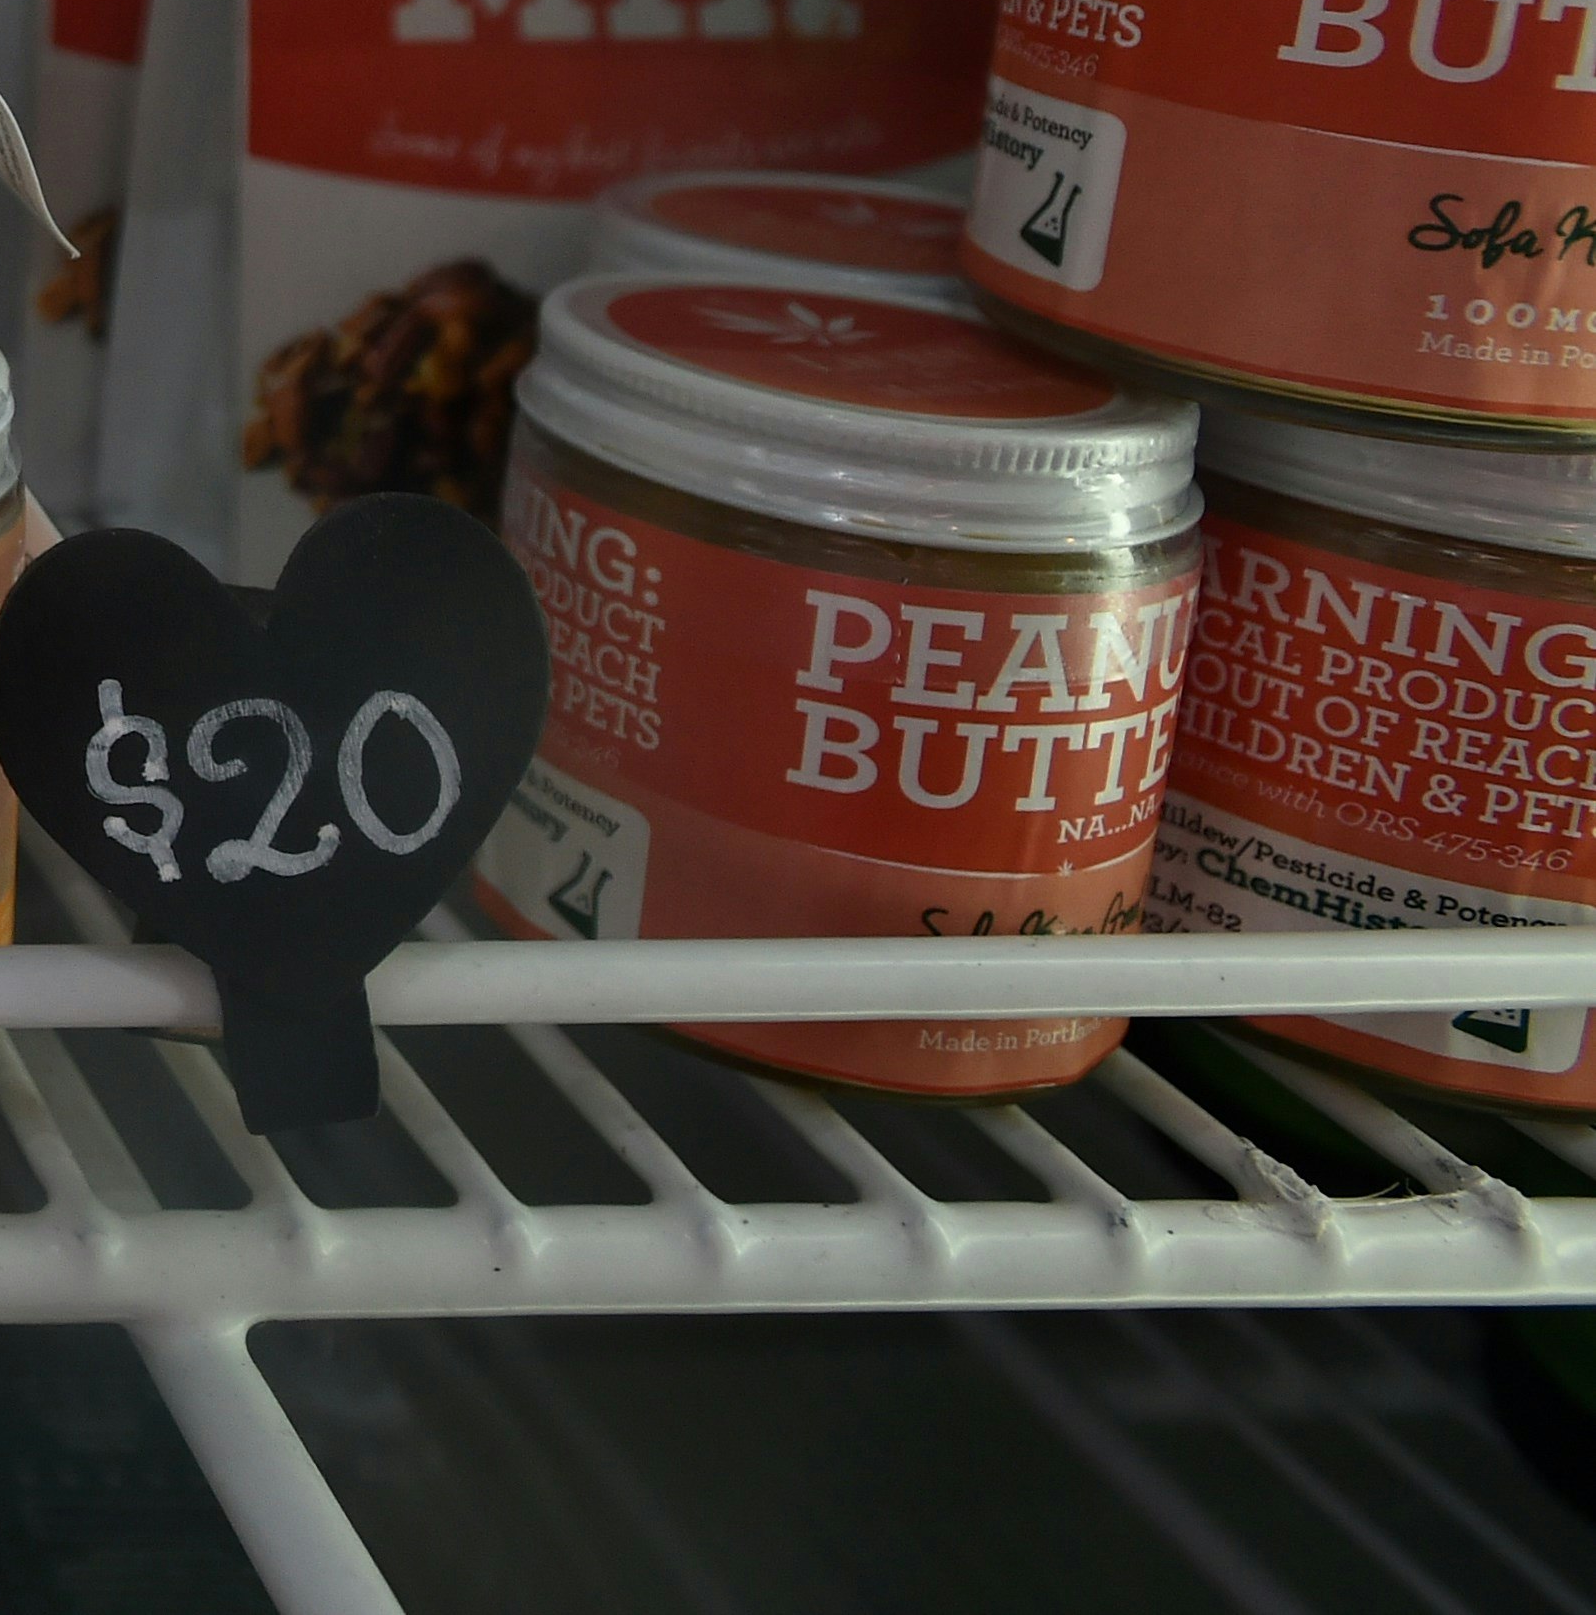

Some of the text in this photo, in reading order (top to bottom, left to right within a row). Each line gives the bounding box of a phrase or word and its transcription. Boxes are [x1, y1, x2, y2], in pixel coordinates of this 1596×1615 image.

[1023, 106, 1094, 151] Potency
[1408, 193, 1545, 270] Sofa
[1416, 330, 1513, 364] Made
[1518, 342, 1551, 366] in
[563, 672, 662, 751] PETS
[1190, 651, 1305, 723] OUT
[1315, 694, 1400, 748] OF
[85, 678, 461, 884] $20
[1421, 772, 1470, 817] &
[1480, 781, 1596, 842] PET
[1335, 801, 1421, 843] ORS
[1423, 830, 1573, 873] 475-346
[1195, 847, 1426, 929] ChemHist
[1403, 889, 1428, 911] &
[918, 1029, 1019, 1052] Made in
